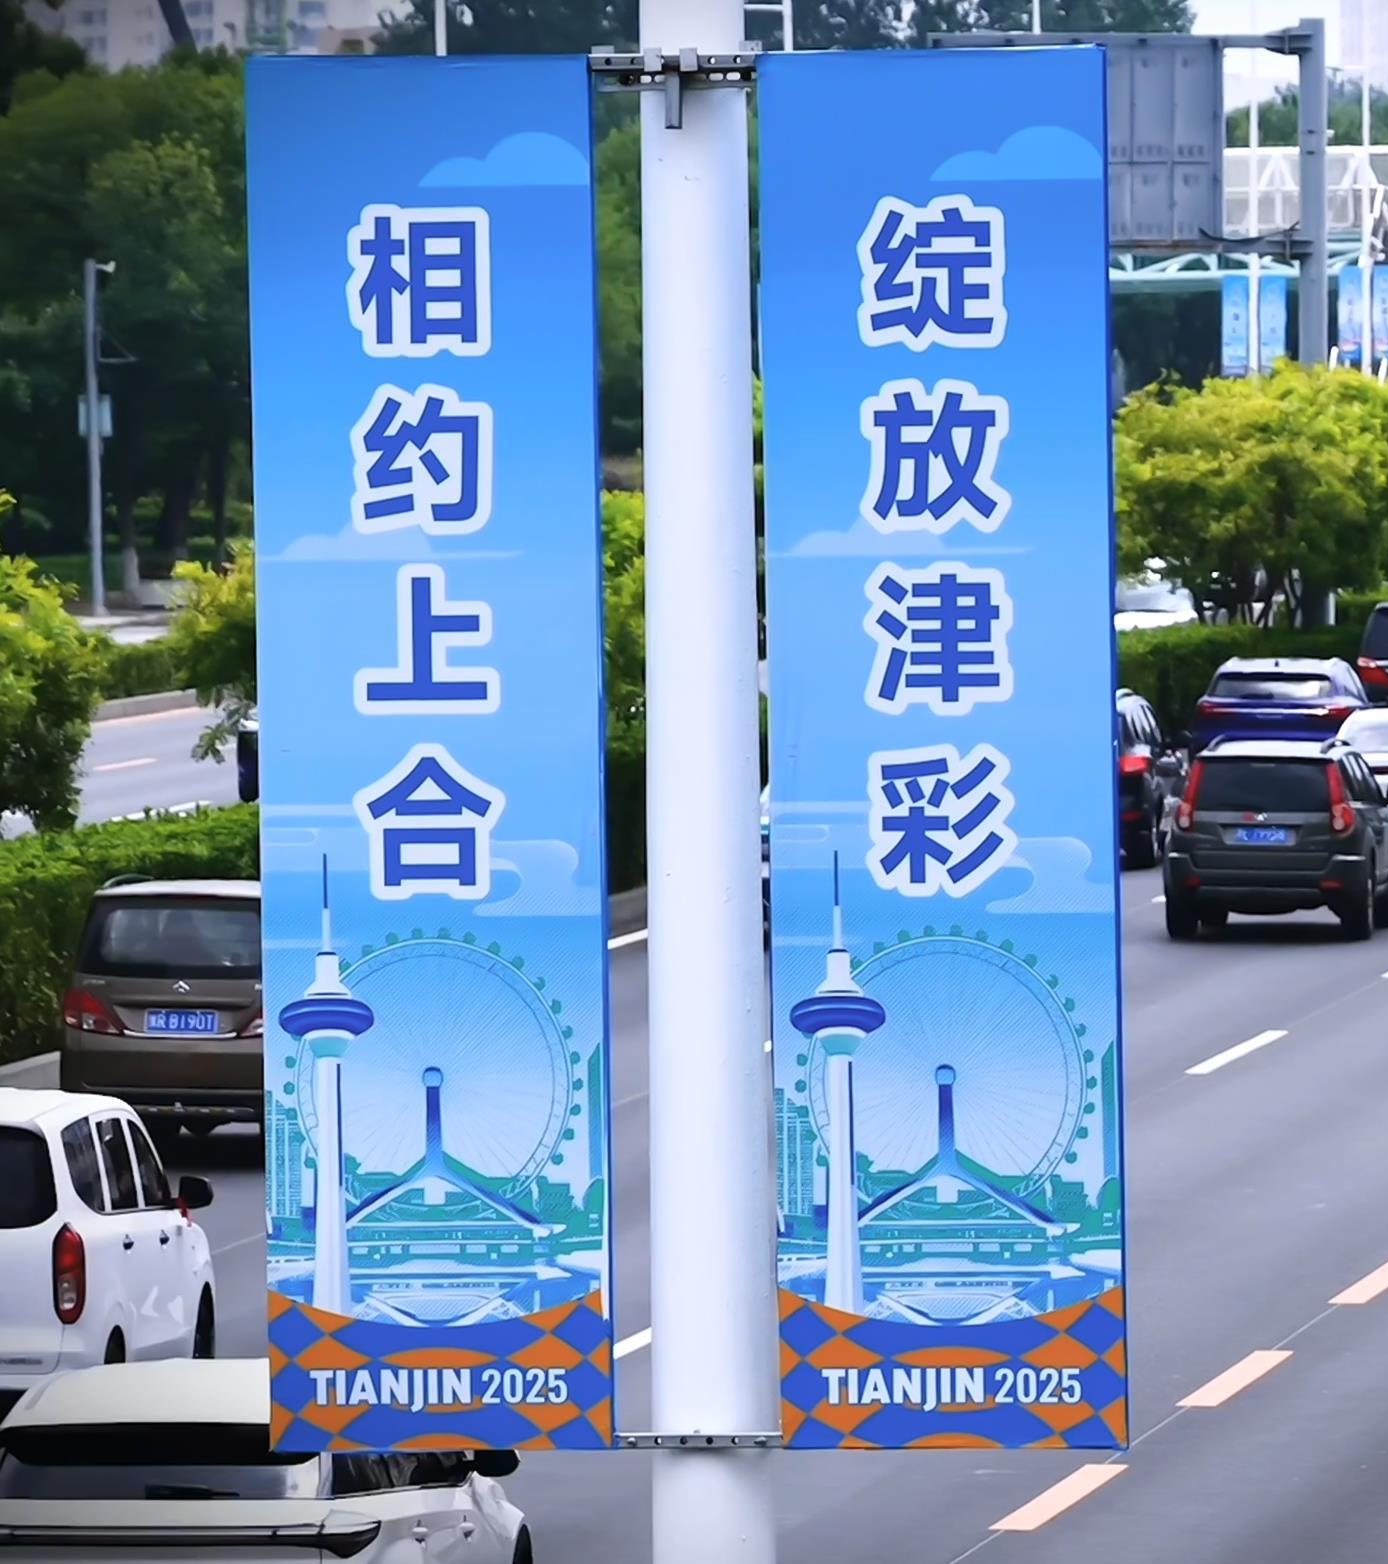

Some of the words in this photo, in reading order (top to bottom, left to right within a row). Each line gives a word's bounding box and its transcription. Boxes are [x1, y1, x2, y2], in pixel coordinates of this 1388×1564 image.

[353, 211, 498, 893] 相约上合
[864, 202, 1010, 891] 绽放津彩
[310, 1367, 473, 1413] TIANJIN
[480, 1367, 569, 1406] 2025
[821, 1366, 985, 1412] TIANJIN
[993, 1366, 1083, 1405] 2025
